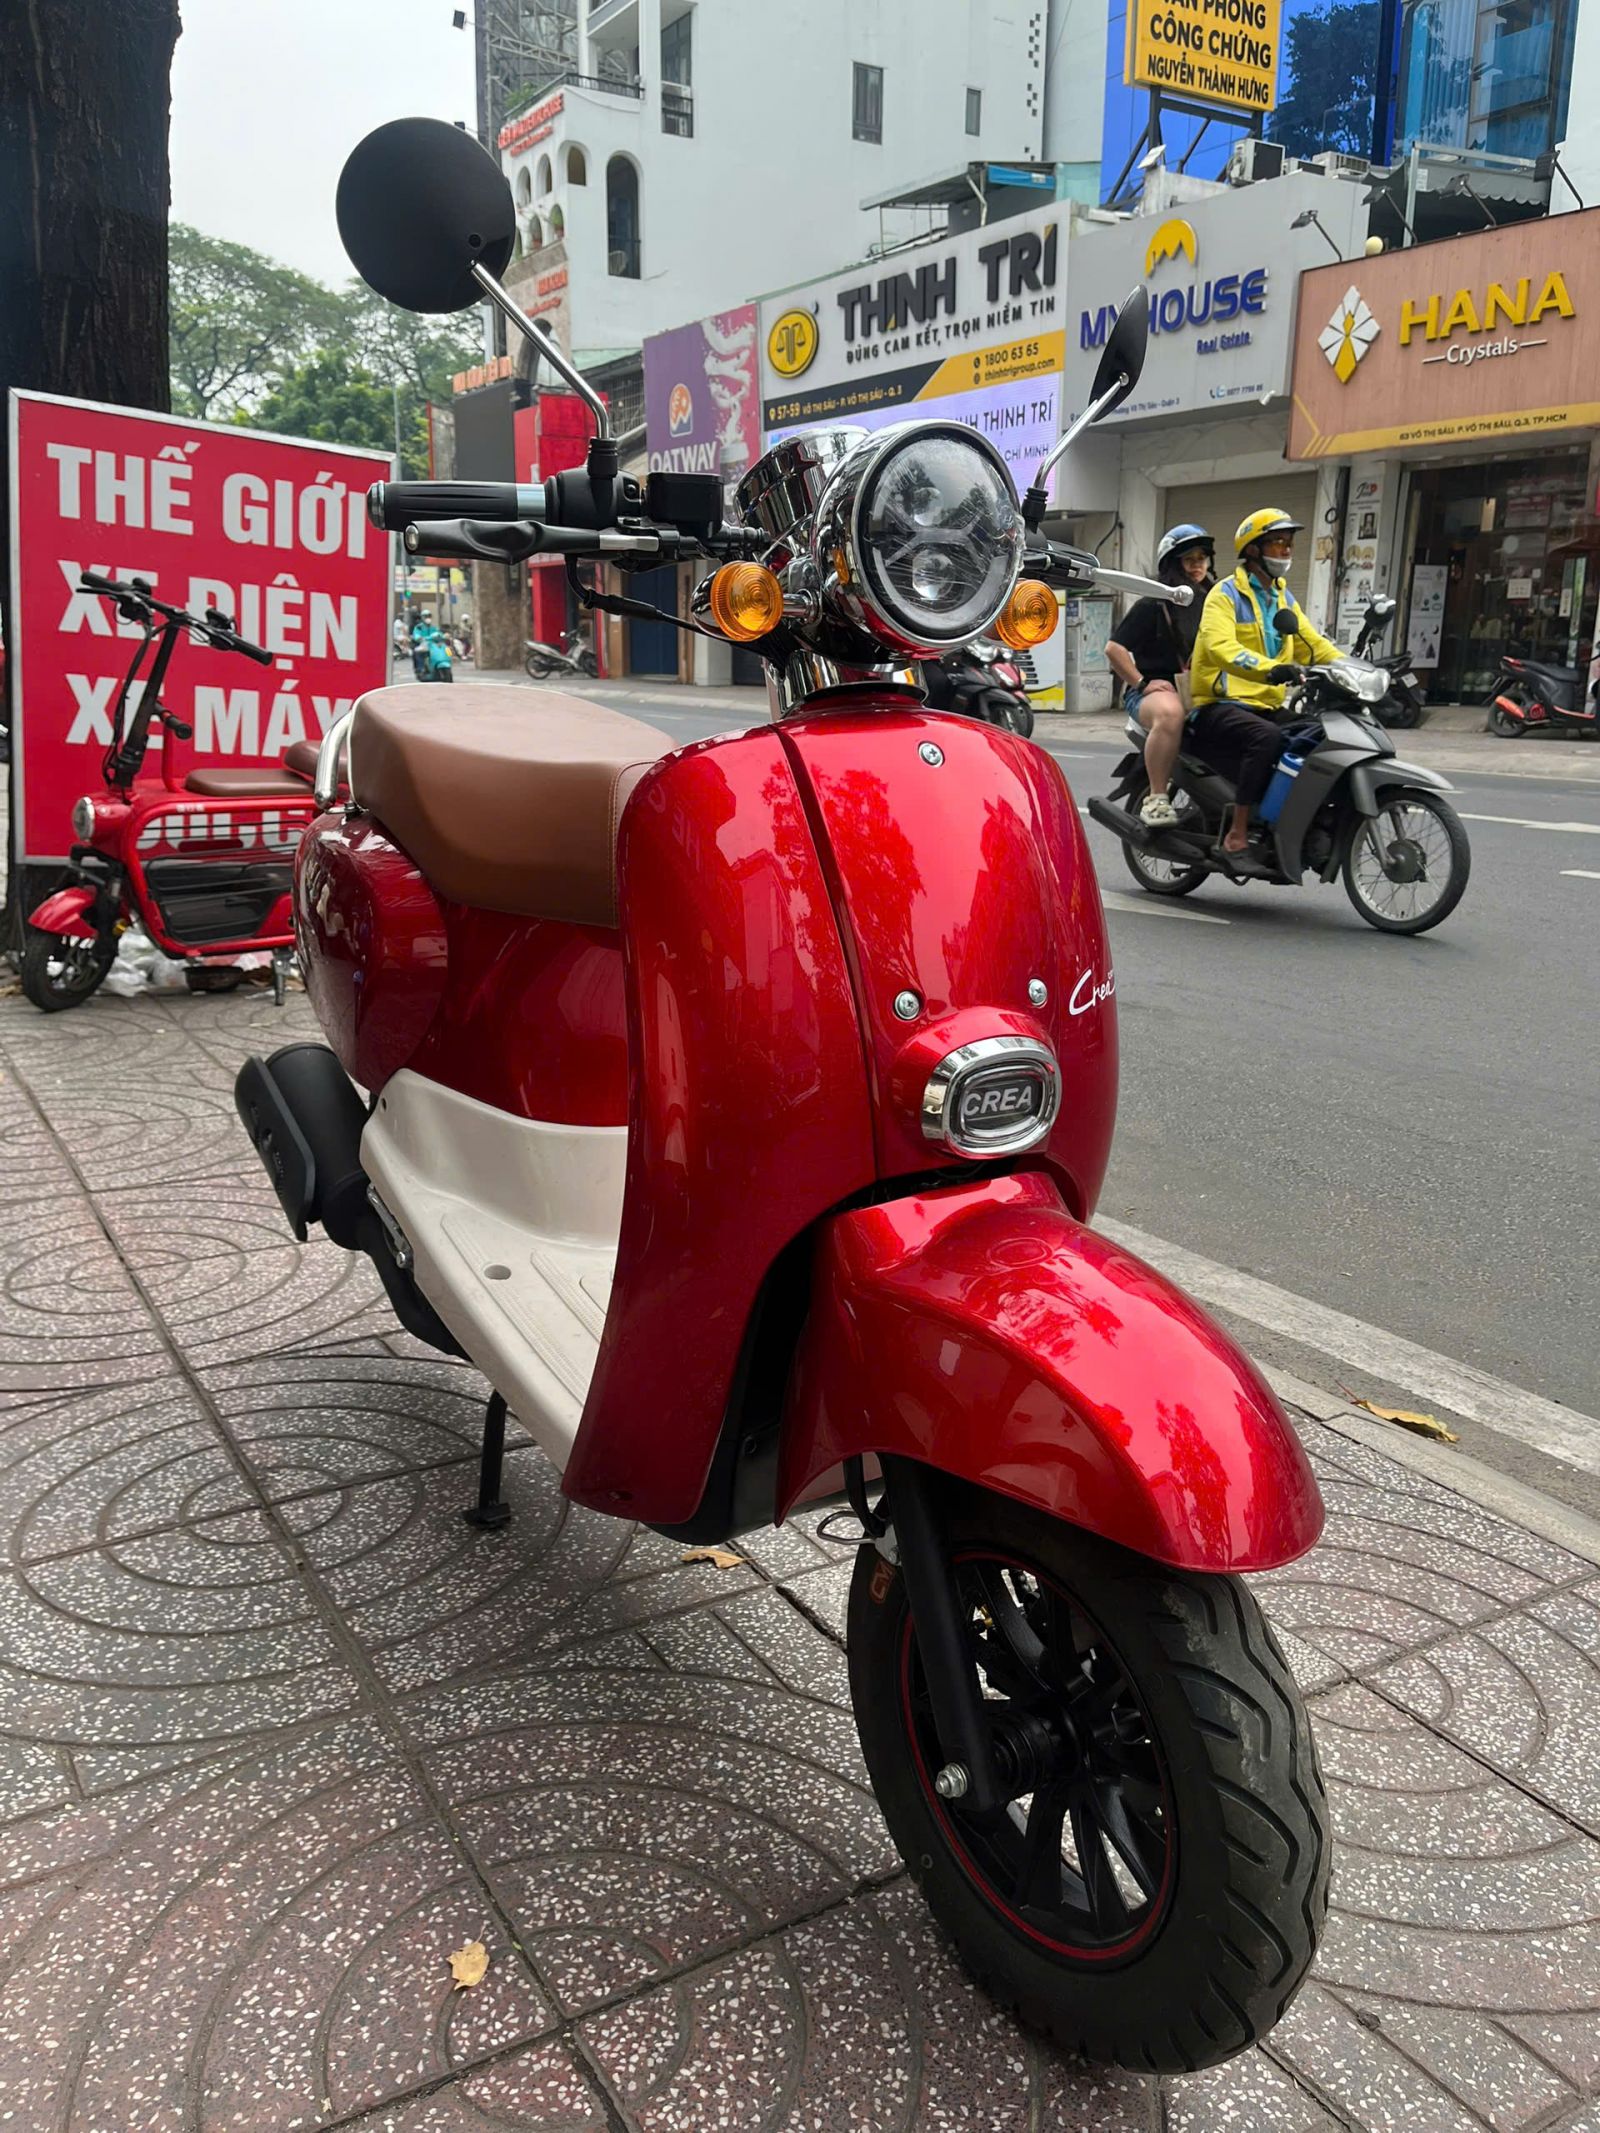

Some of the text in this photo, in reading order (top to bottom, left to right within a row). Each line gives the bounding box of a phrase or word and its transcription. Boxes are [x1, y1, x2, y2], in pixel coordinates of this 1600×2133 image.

[1150, 10, 1272, 69] CÔNG CHỨNG
[1147, 52, 1269, 104] NGUYỄN THÀNH HƯNG
[1148, 268, 1269, 335] HOUSE
[1400, 270, 1576, 347] HANA
[884, 335, 910, 355] CAM
[916, 321, 941, 347] KẾT,
[944, 316, 981, 339] TRỌN
[987, 301, 1022, 329] NIỀM
[1031, 296, 1056, 318] TIN
[985, 342, 1039, 366] 1800 63 65
[1197, 331, 1252, 356] Real Estate
[1446, 336, 1519, 366] Crystals
[985, 358, 1056, 380] thinhtrigroup.com
[777, 402, 801, 420] 57-59
[984, 408, 1026, 436] THỊNH
[1031, 393, 1053, 423] TRÍ
[1533, 413, 1567, 425] TP.HCM
[650, 441, 717, 473] OATWAY
[1004, 443, 1049, 462] CHÍ MINH
[47, 441, 367, 560] THẾ GIỚI
[185, 573, 358, 670] ĐIỆN
[963, 1085, 1032, 1116] CREA
